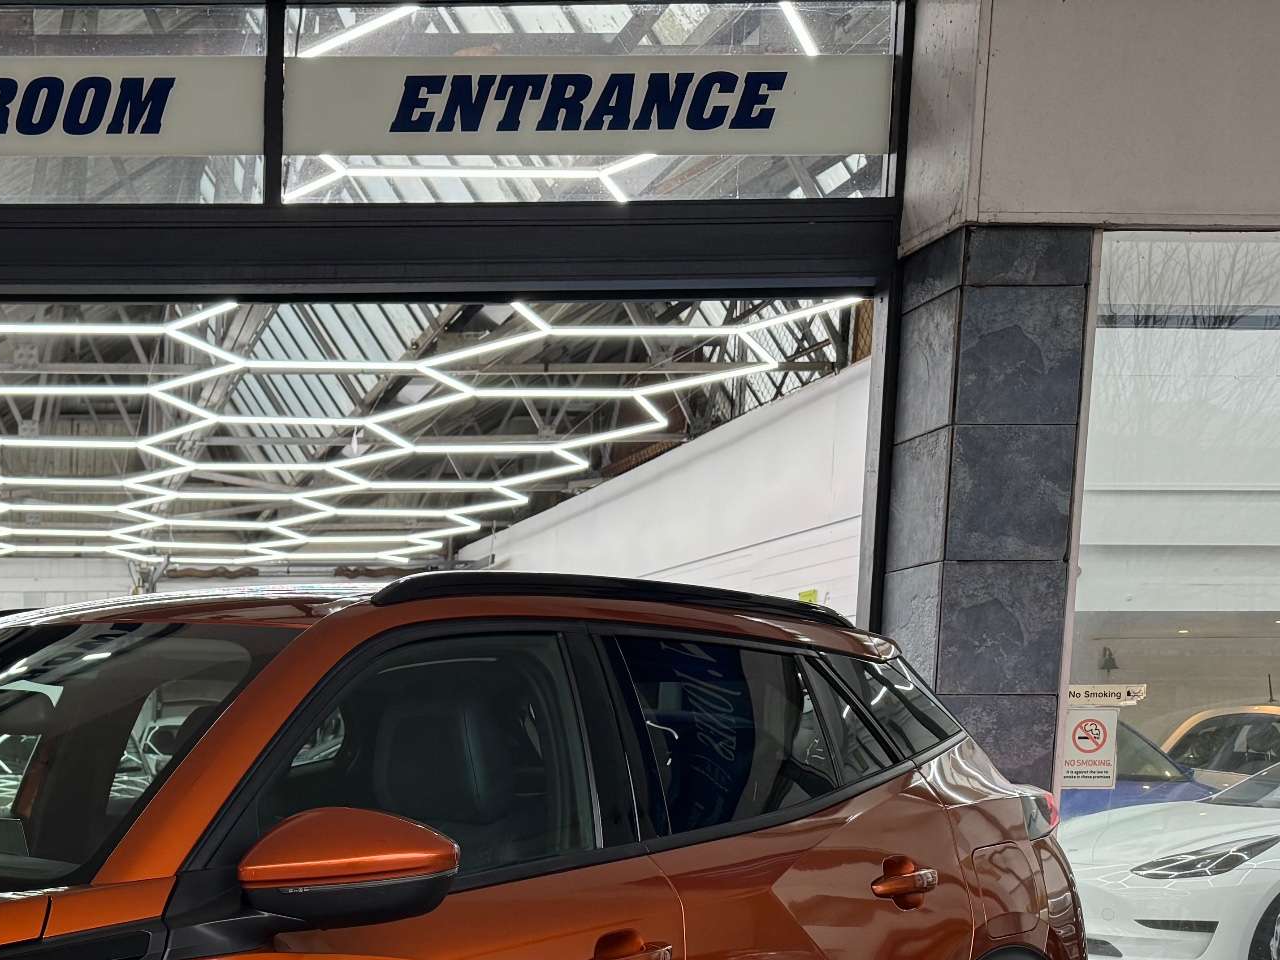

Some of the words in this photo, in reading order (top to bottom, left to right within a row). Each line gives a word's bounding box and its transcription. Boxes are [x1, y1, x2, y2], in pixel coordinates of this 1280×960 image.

[389, 71, 788, 134] ENTRANCE
[1068, 690, 1081, 699] No
[1084, 690, 1122, 700] Smoking
